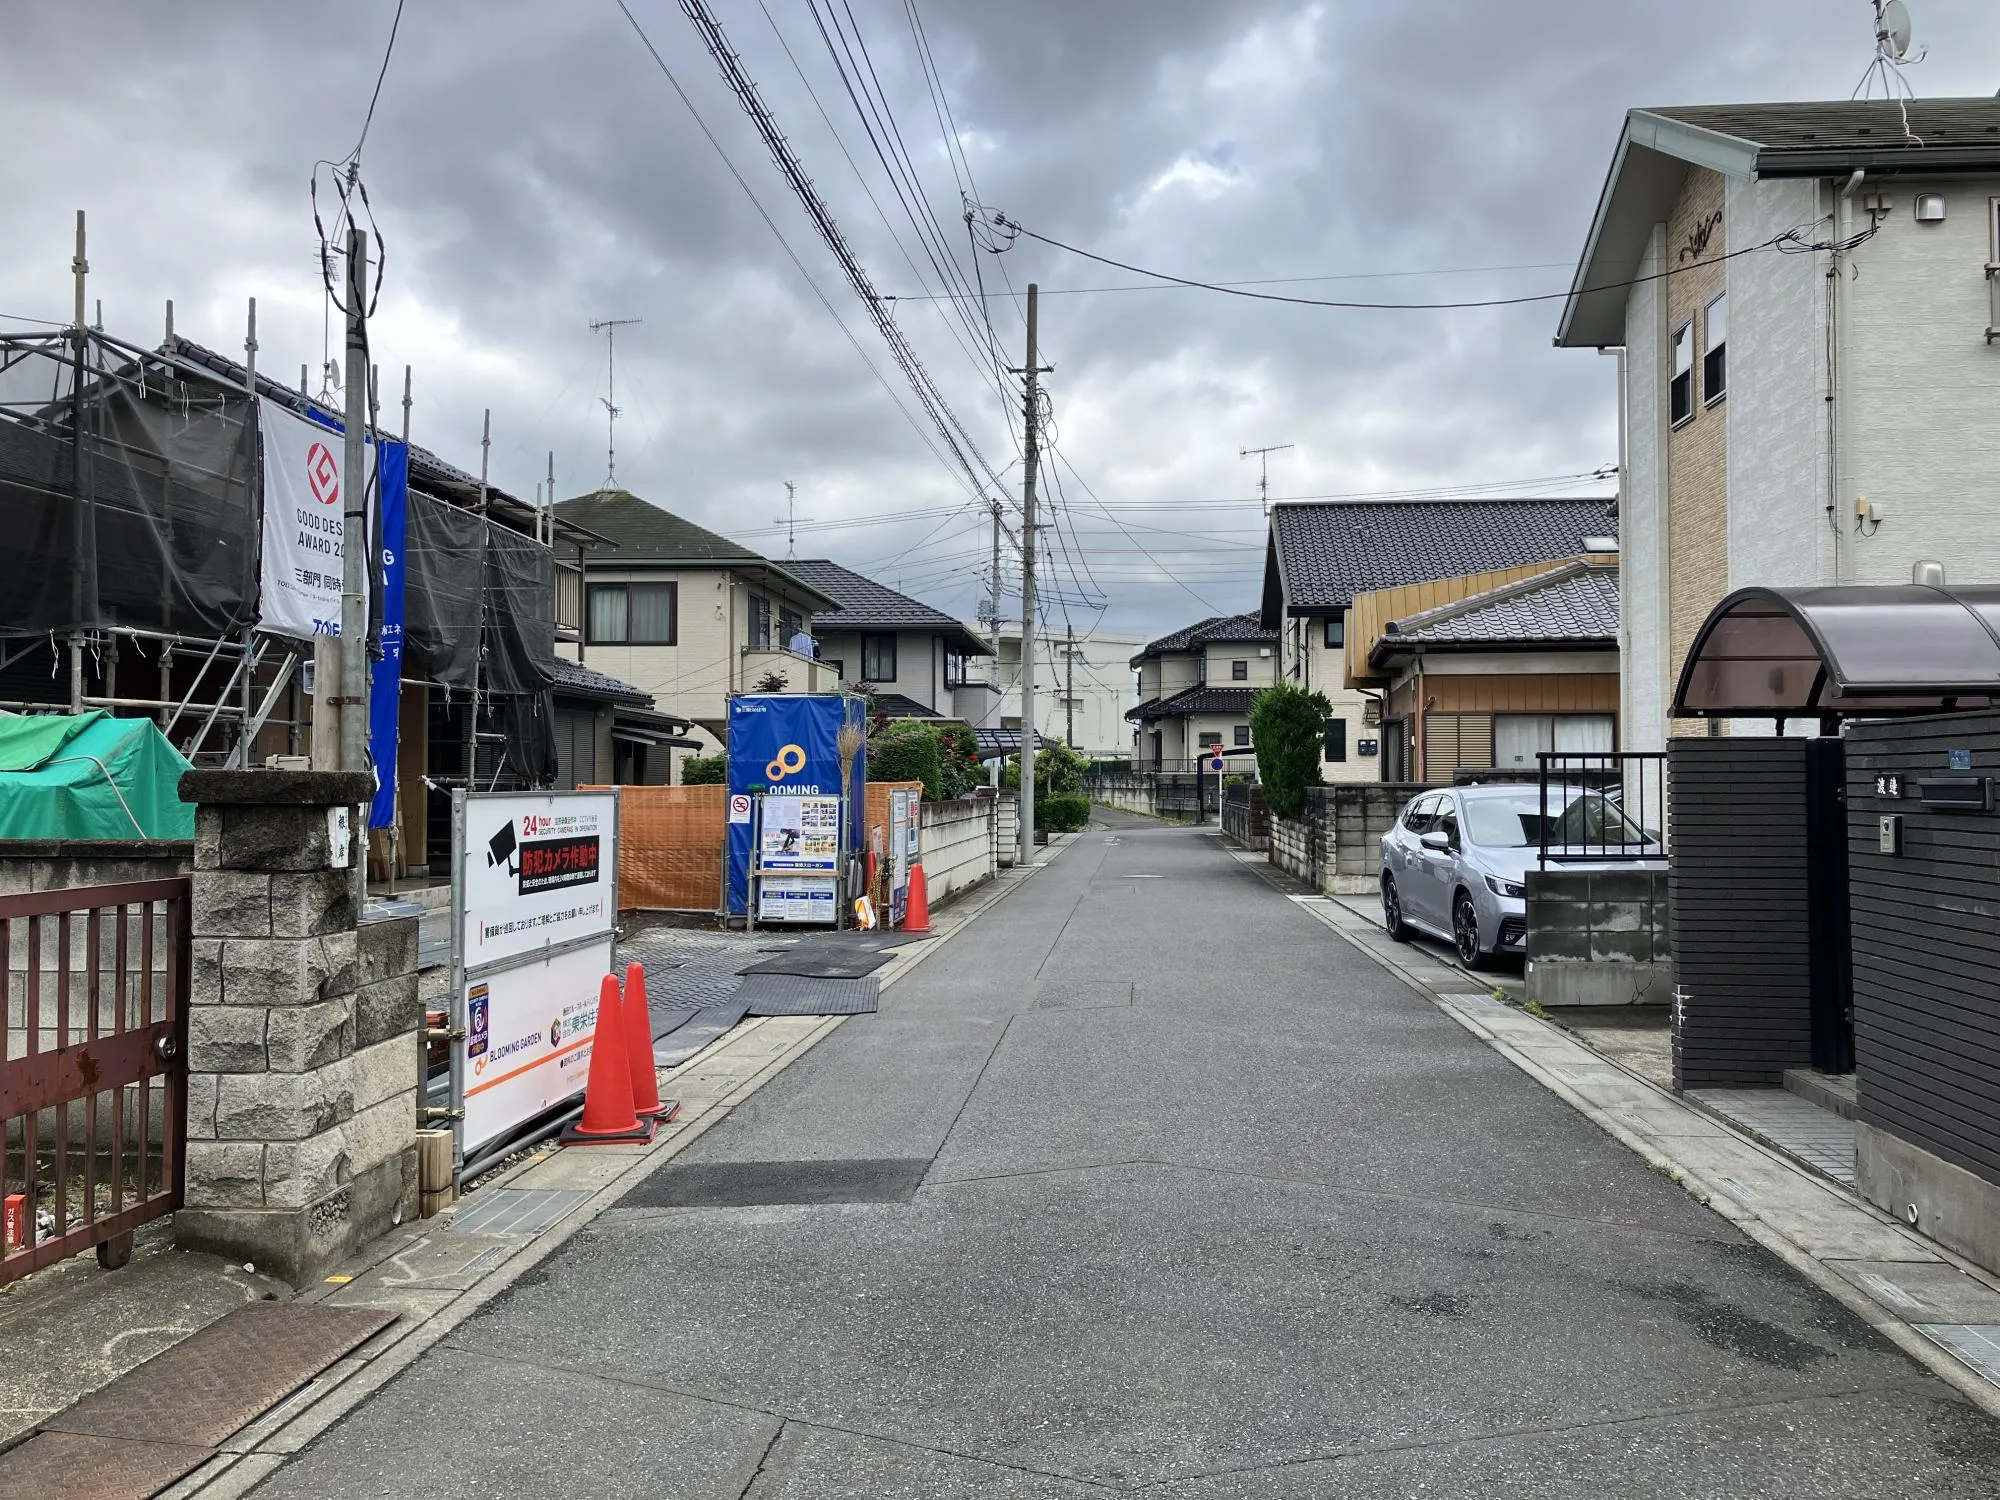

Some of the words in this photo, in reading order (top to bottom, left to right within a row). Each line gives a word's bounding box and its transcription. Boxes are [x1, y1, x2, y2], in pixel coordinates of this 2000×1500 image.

[297, 508, 320, 530] GOOD
[297, 531, 330, 554] AWARD
[294, 567, 321, 589] 三部門
[323, 575, 344, 592] 同時
[523, 815, 537, 836] 24
[538, 817, 551, 827] hour
[538, 827, 556, 836] SECURITY
[523, 843, 597, 876] 防犯カメラ作動中
[489, 1040, 519, 1062] BLOOMING
[519, 1032, 542, 1051] GARDEN
